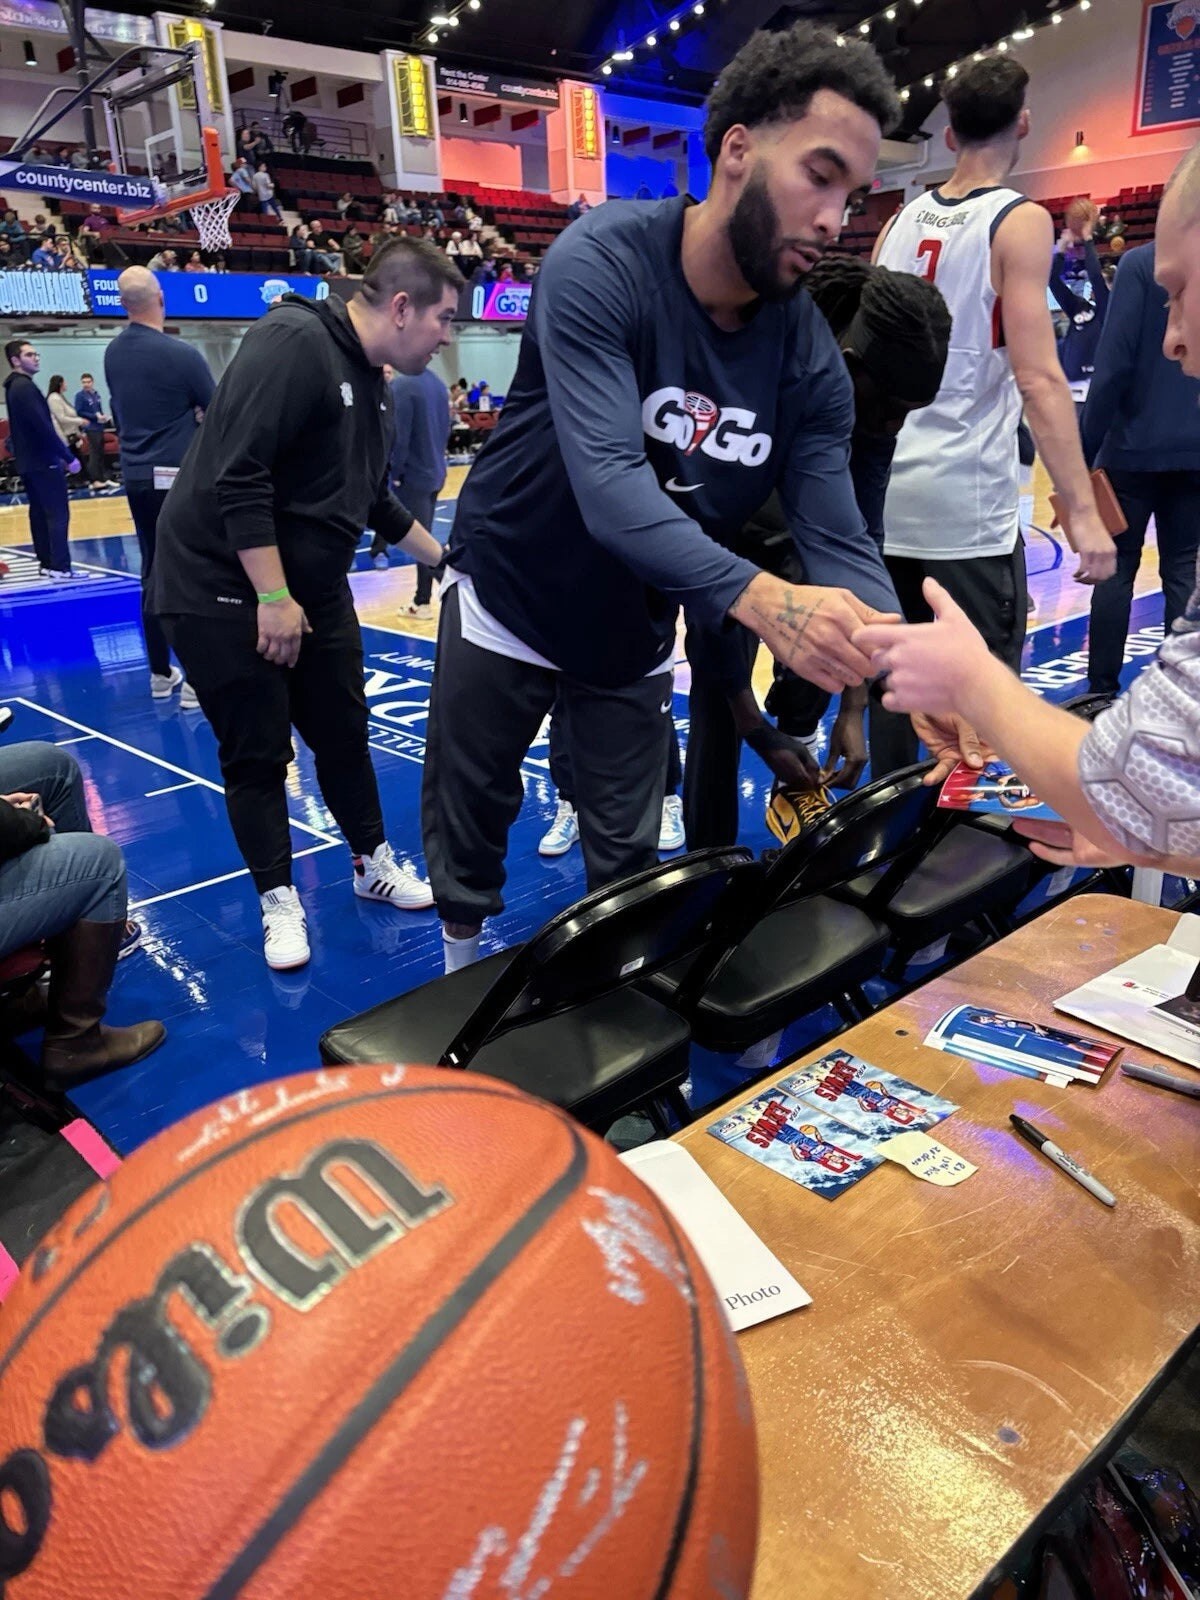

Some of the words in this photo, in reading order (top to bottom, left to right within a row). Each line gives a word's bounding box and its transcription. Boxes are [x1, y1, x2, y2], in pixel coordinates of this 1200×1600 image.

[15, 170, 152, 198] countycenter.biz
[193, 283, 208, 303] 0
[724, 1284, 782, 1311] Photo
